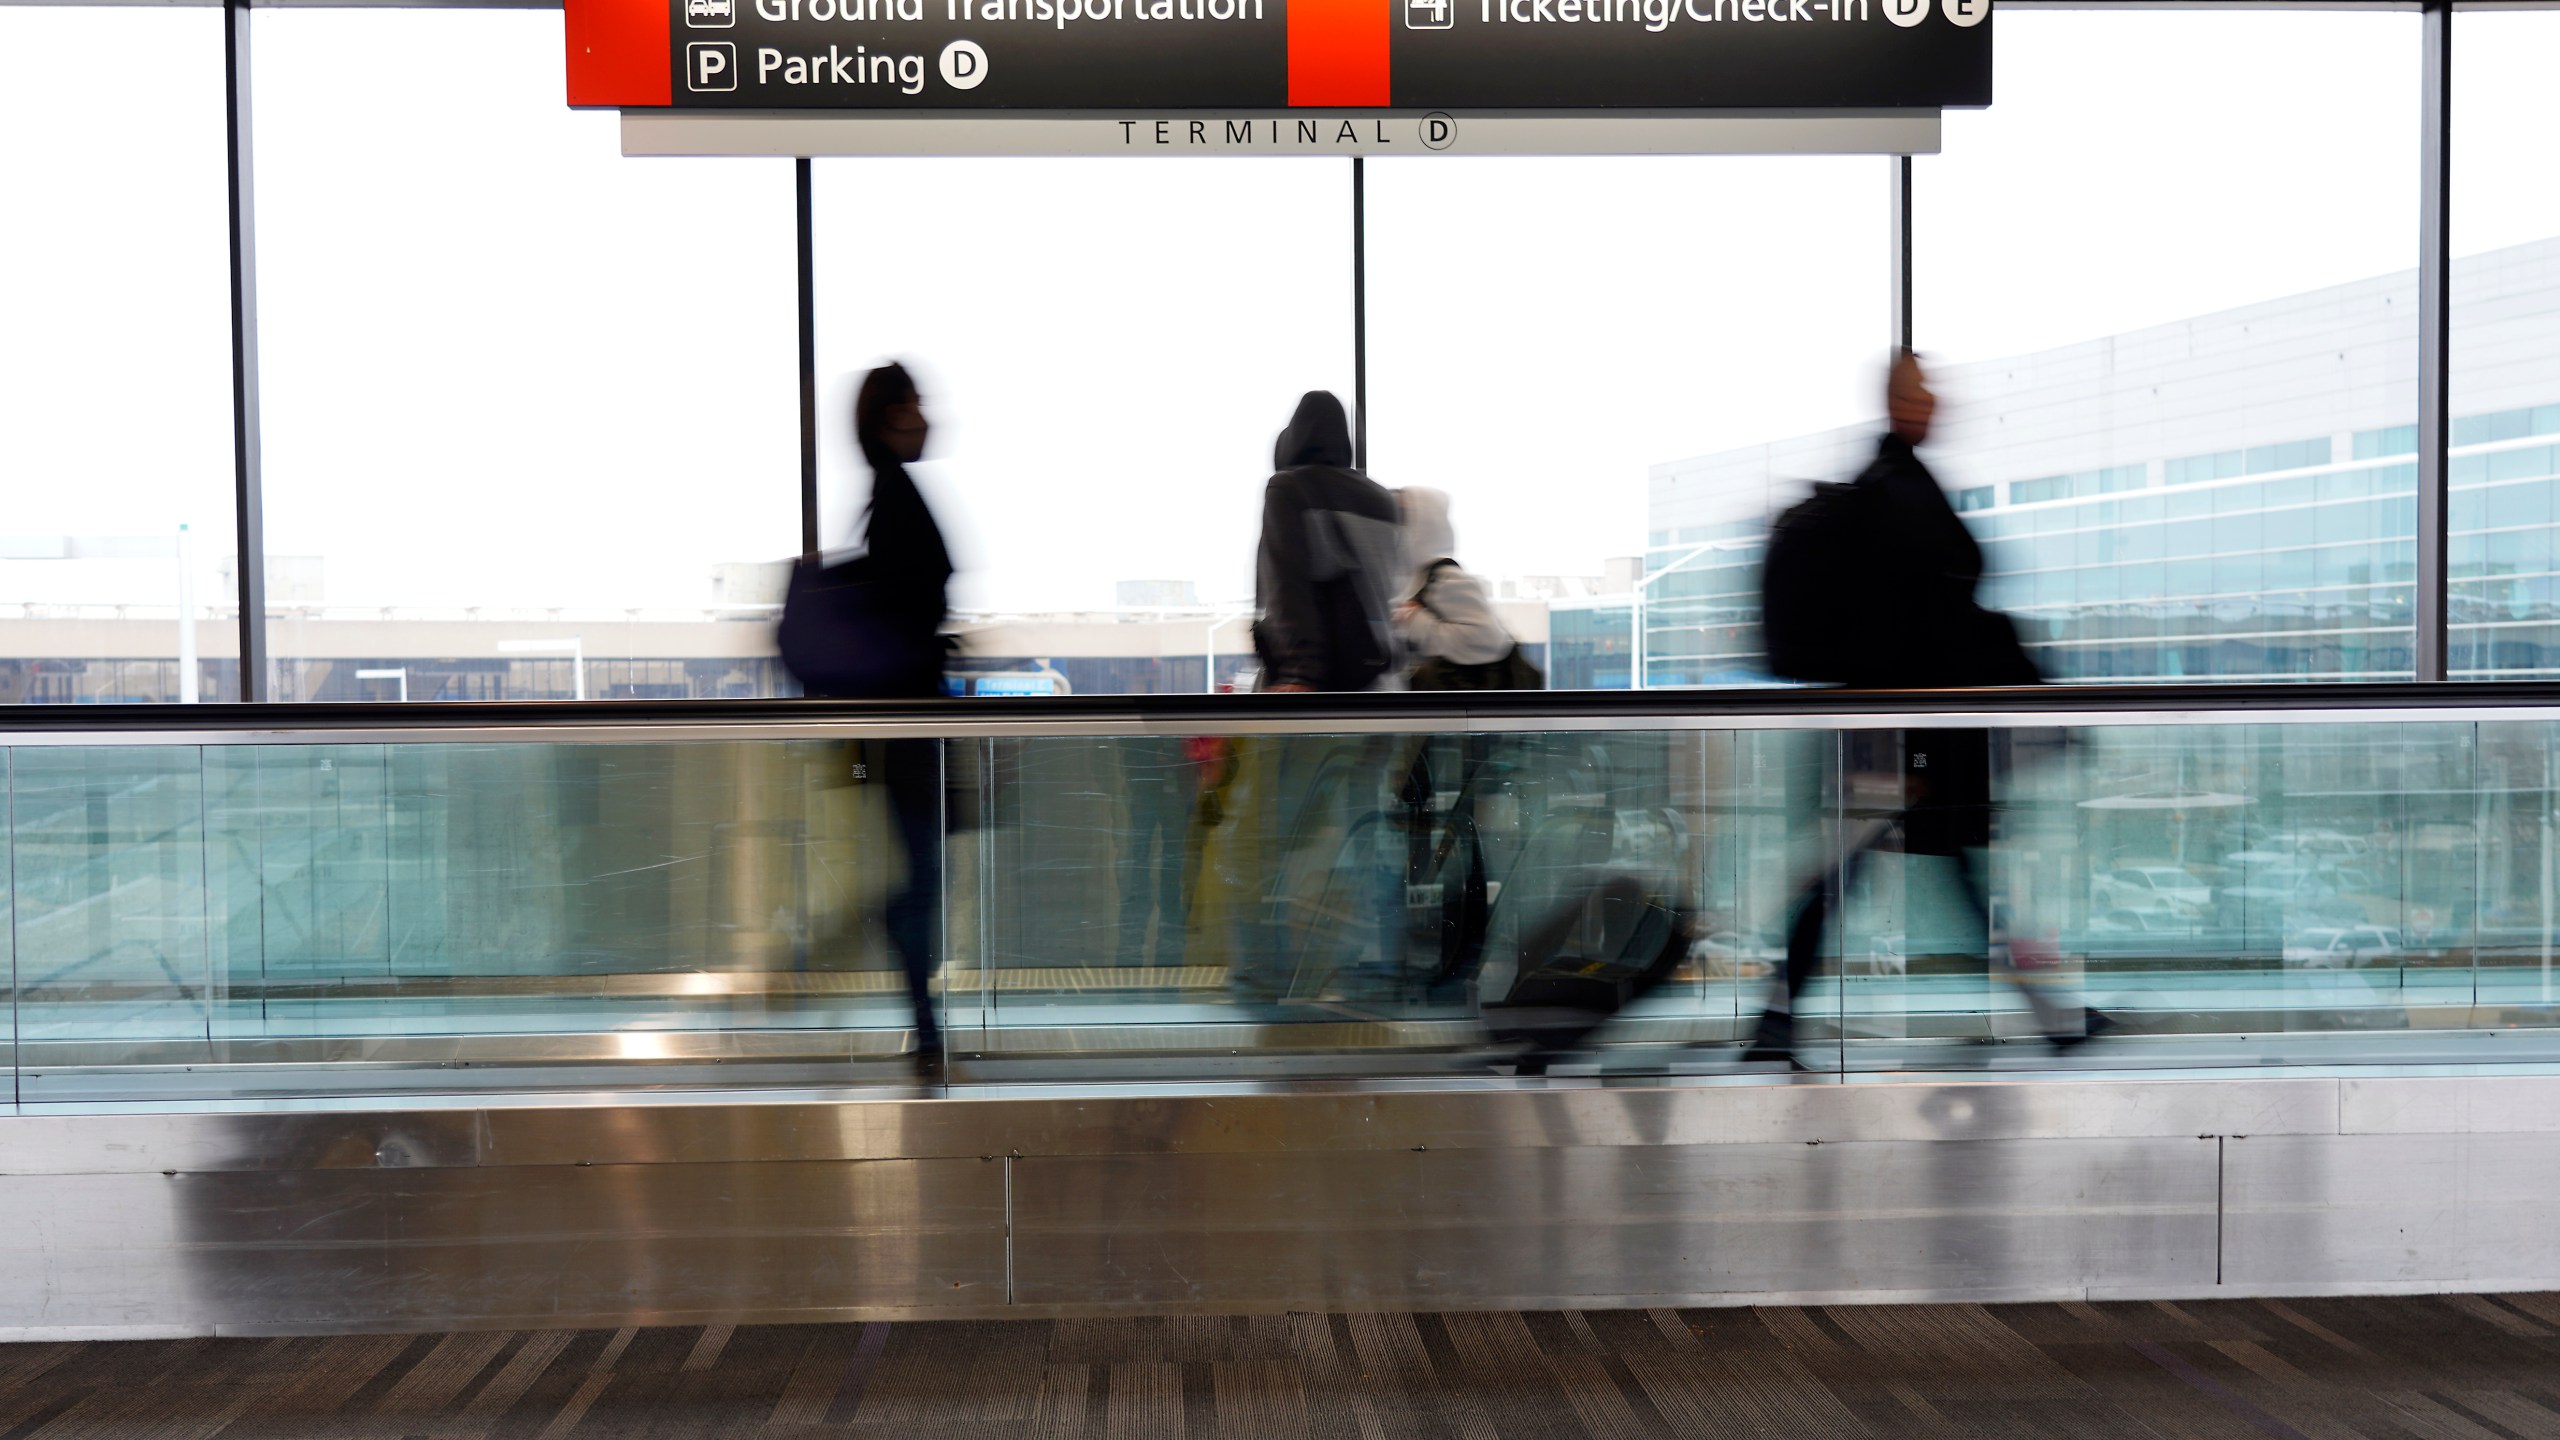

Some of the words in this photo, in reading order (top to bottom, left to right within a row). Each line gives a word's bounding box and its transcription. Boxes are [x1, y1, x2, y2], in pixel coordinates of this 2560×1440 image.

[700, 50, 726, 84] P
[758, 45, 925, 95] Parking
[1119, 120, 1390, 144] TERMINAL
